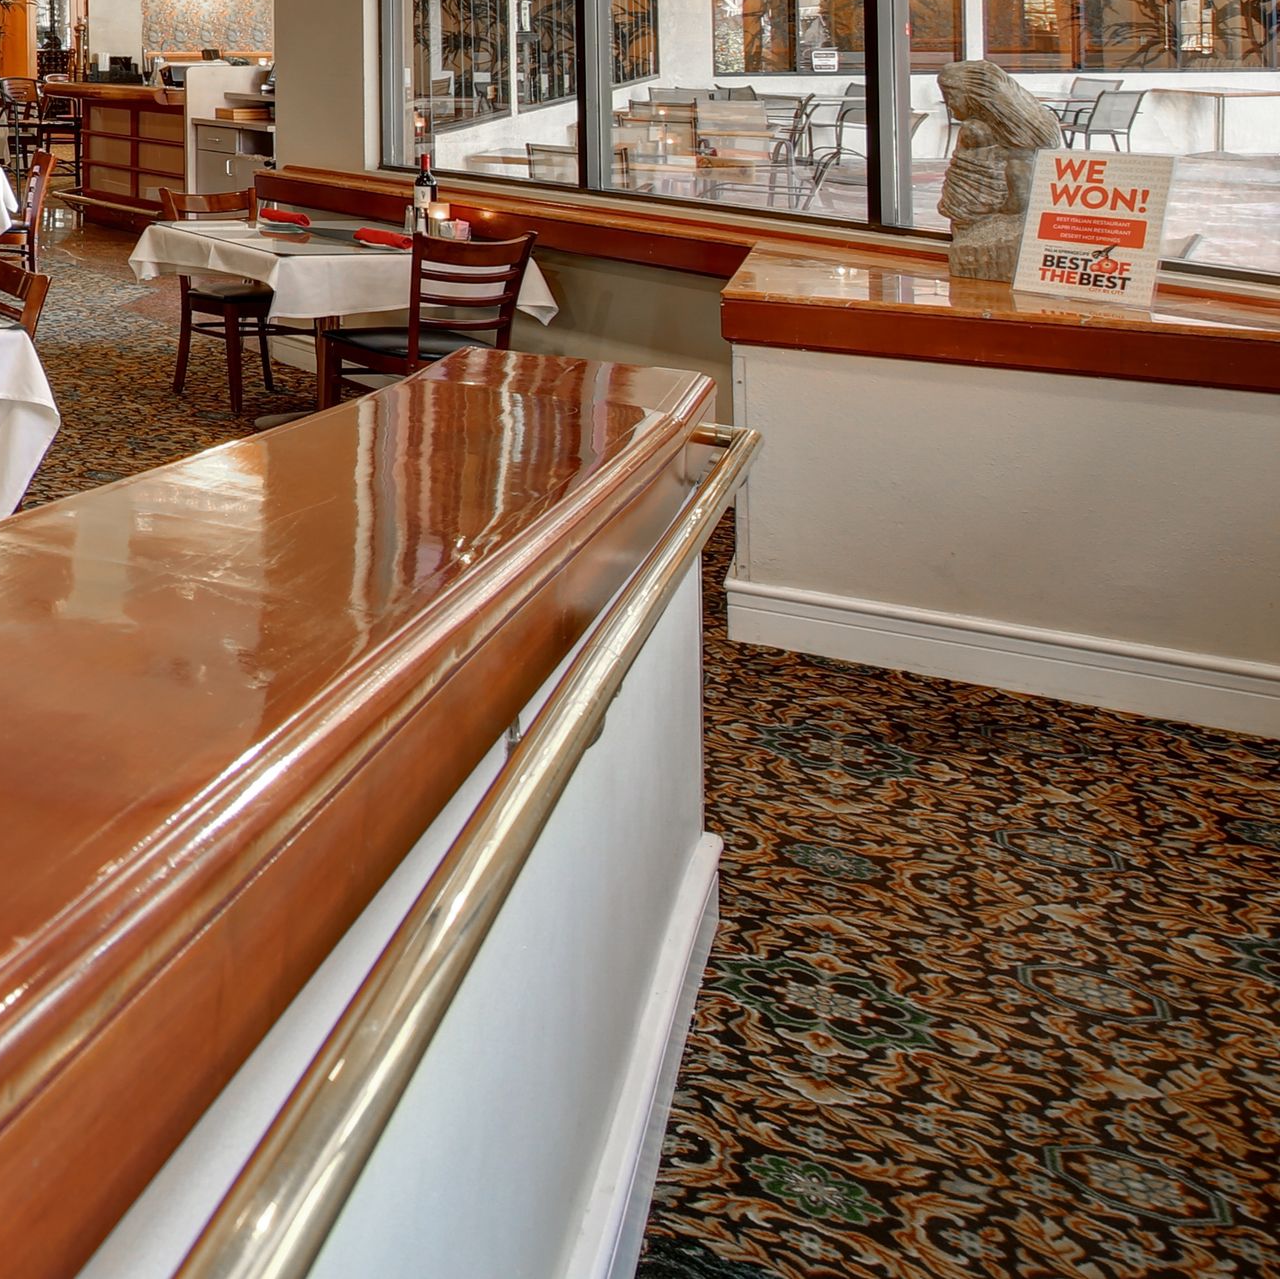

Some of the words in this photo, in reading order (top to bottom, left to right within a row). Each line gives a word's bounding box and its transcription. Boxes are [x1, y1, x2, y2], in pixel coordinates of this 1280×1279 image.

[1054, 157, 1108, 184] WE
[1050, 183, 1150, 214] WON!
[1093, 219, 1131, 227] RESTAURANT
[1093, 227, 1131, 236] RESTAURANT
